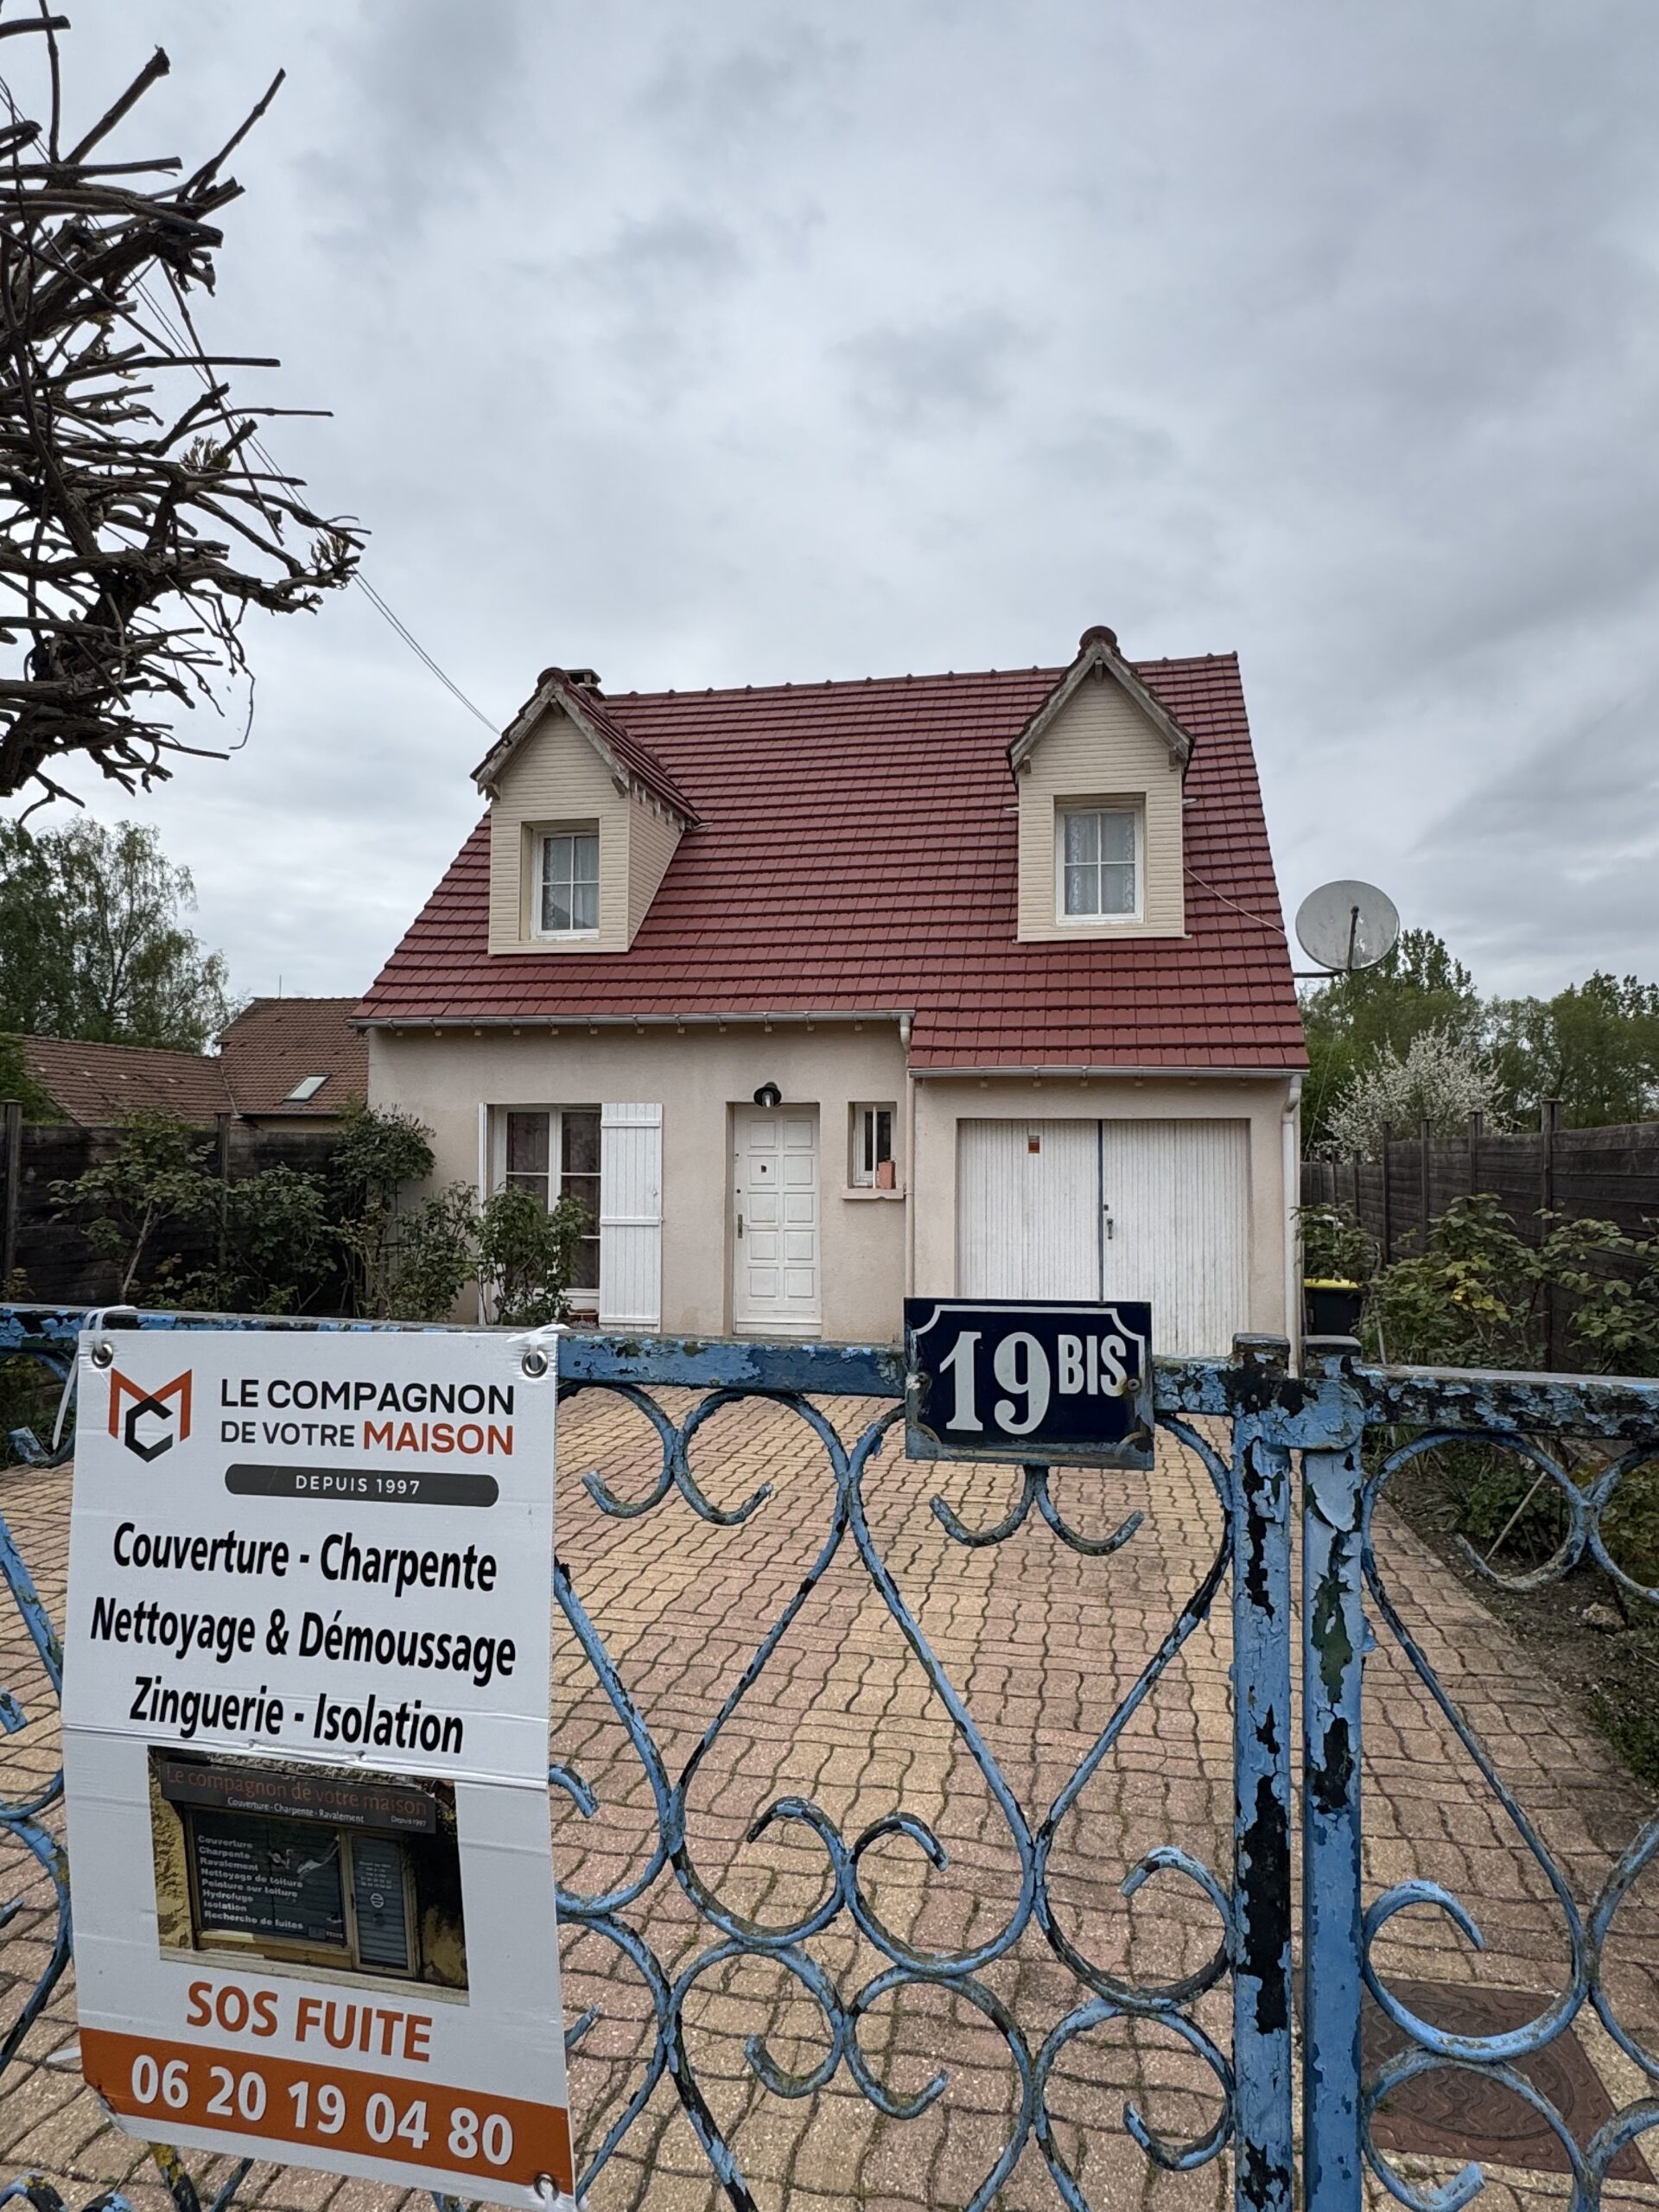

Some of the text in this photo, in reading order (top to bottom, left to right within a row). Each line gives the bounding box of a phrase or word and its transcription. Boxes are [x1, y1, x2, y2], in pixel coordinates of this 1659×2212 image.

[220, 1378, 515, 1415] LE COMPAGNON
[939, 1332, 1127, 1434] 19 BIS
[220, 1421, 514, 1455] DE VOTRE MAISON
[296, 1475, 420, 1495] DEPUIS 1997
[113, 1522, 289, 1577] Couverture
[320, 1532, 497, 1598] Charpente
[90, 1597, 516, 1687] Nettoyage & Démoussage
[130, 1676, 283, 1738] Zinguerie
[314, 1693, 464, 1754] Isolation
[166, 1764, 184, 1783] Le
[188, 1771, 287, 1799] compagnon
[315, 1789, 359, 1807] votre
[364, 1796, 428, 1815] maison
[227, 1796, 269, 1811] Couverture
[274, 1803, 314, 1817] Charpente
[319, 1808, 365, 1823] Ravalement
[198, 1835, 253, 1849] Couverture
[199, 1846, 251, 1859] Charpente
[200, 1857, 259, 1872] Ravalement
[200, 1867, 303, 1888] Nettoyage de toiture
[201, 1878, 298, 1897] Peinture sur toiture
[202, 1889, 254, 1904] Hydrofuge
[203, 1900, 247, 1912] Isolation
[204, 1910, 303, 1929] Recherche de fuites
[187, 1980, 433, 2063] SOS FUITE
[130, 2055, 513, 2165] 06 20 19 04 80
